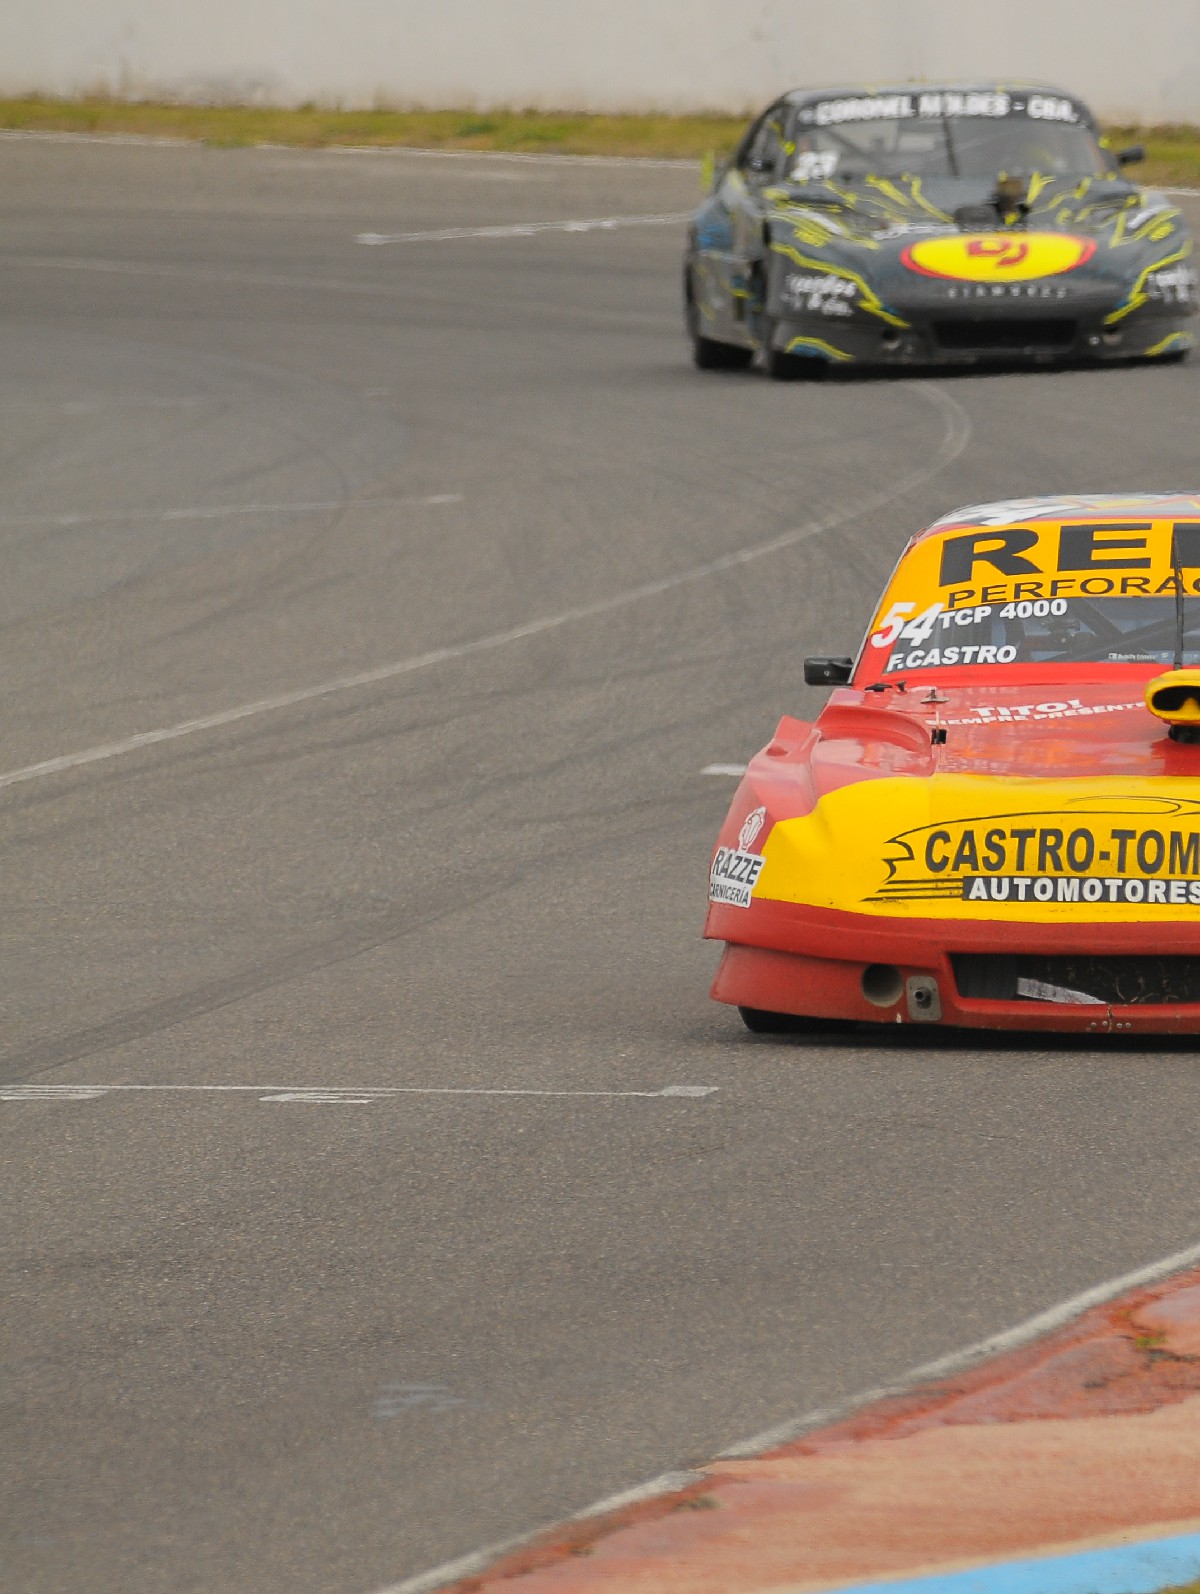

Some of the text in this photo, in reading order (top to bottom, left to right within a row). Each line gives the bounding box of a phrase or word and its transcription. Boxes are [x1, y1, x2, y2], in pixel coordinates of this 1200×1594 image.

[870, 602, 945, 649] 54
[938, 598, 1068, 629] TCP 4000
[886, 645, 1018, 673] F.CASTRO
[969, 699, 1084, 716] TITO!
[712, 850, 763, 885] RAZZE
